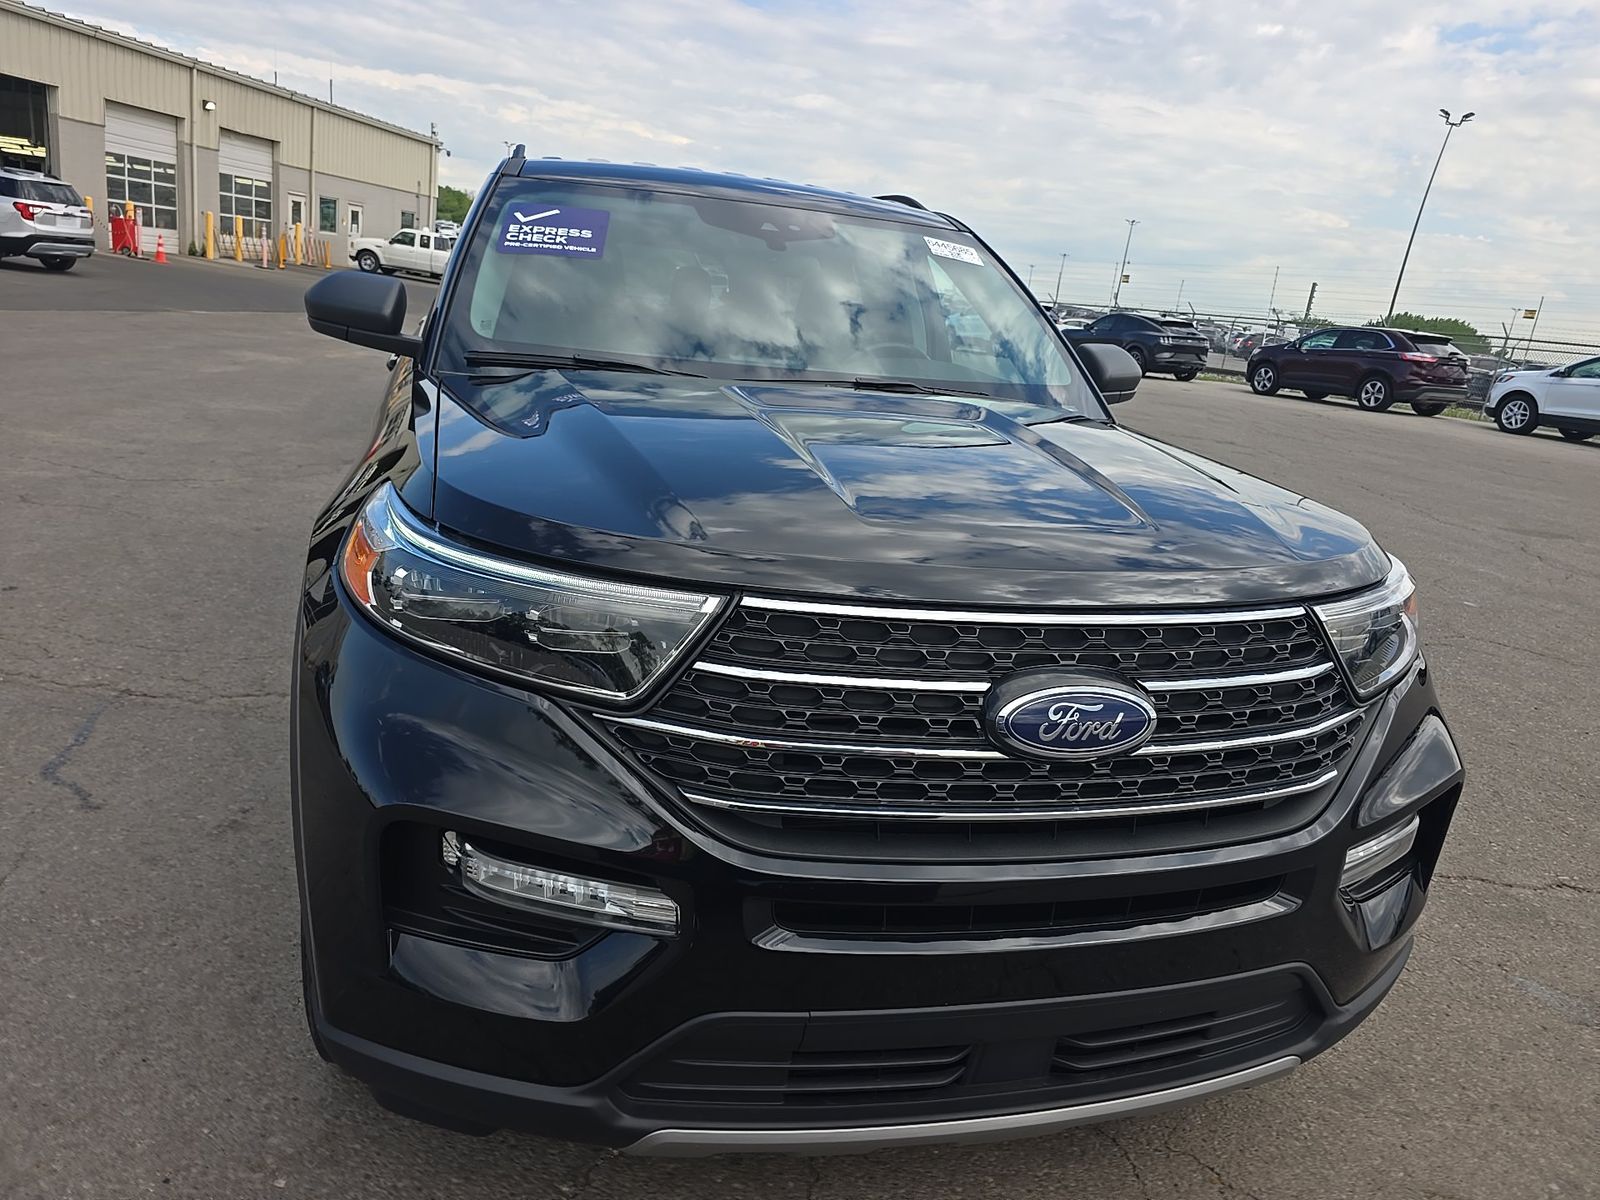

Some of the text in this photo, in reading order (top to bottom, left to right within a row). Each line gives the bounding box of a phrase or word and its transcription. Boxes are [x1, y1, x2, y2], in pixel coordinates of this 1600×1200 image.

[508, 224, 592, 238] EXPRESS
[506, 232, 567, 244] CHECK
[503, 242, 597, 253] PRE-CERTIFIED VEHICLE
[1038, 702, 1125, 742] Ford
